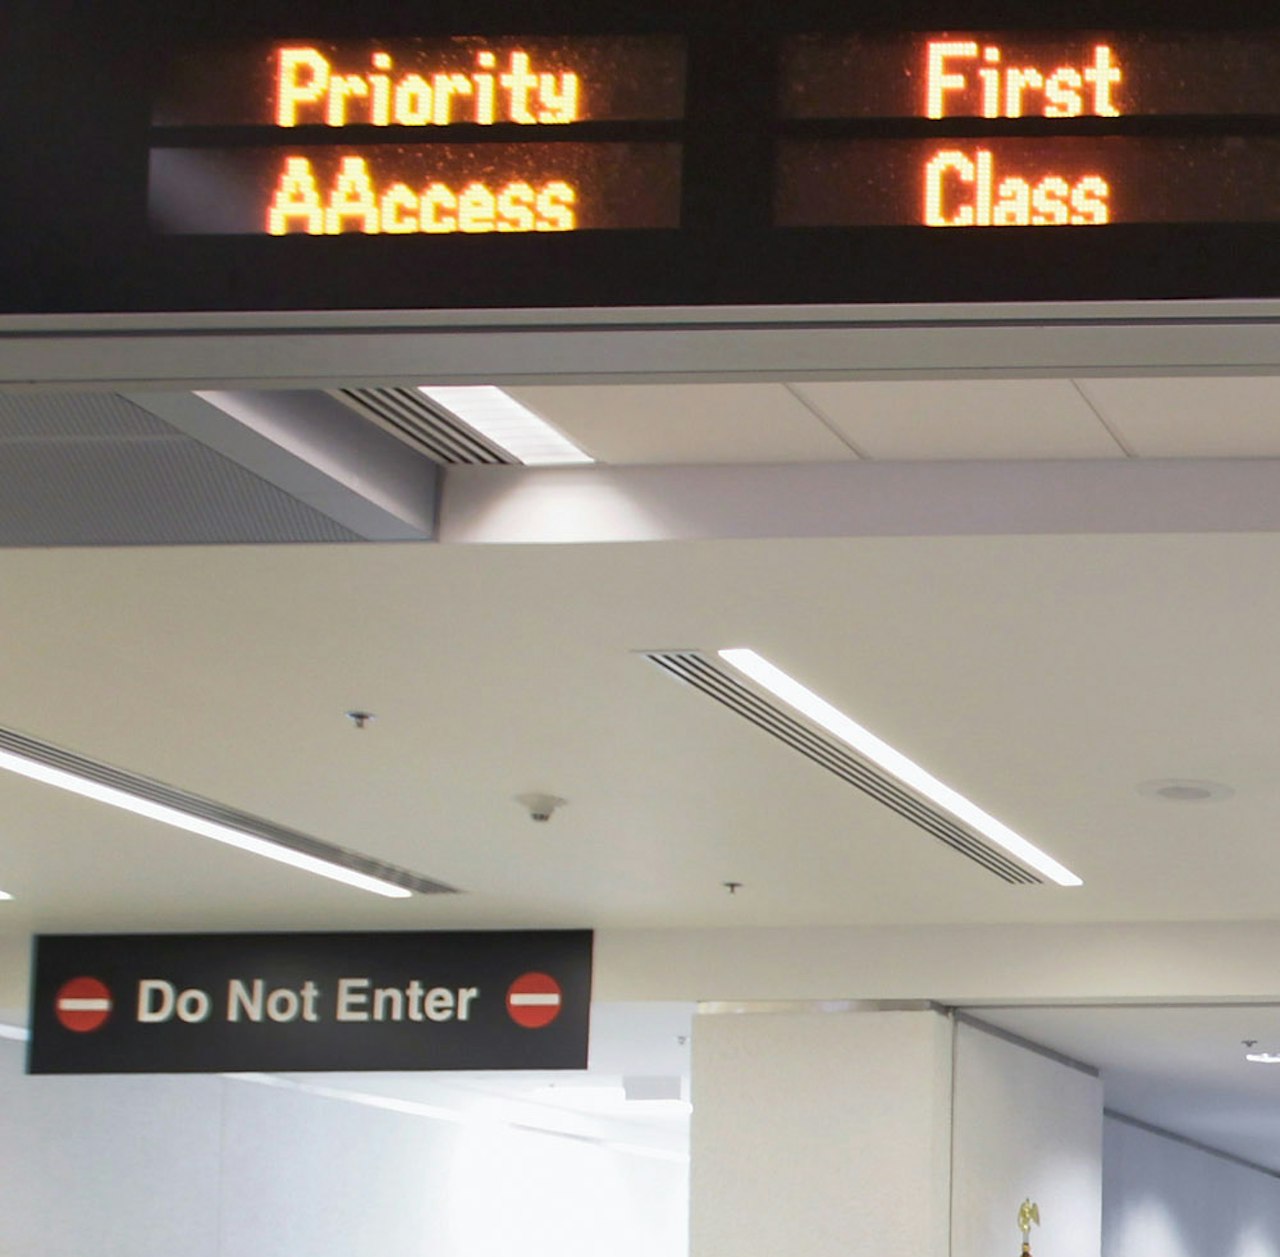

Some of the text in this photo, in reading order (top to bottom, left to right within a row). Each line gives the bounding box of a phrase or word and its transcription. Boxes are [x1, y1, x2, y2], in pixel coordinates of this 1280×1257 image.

[272, 46, 582, 128] Priority
[920, 38, 1122, 119] First
[264, 155, 577, 235] AAccess
[920, 146, 1110, 228] Class
[137, 978, 478, 1022] Do Not Enter
